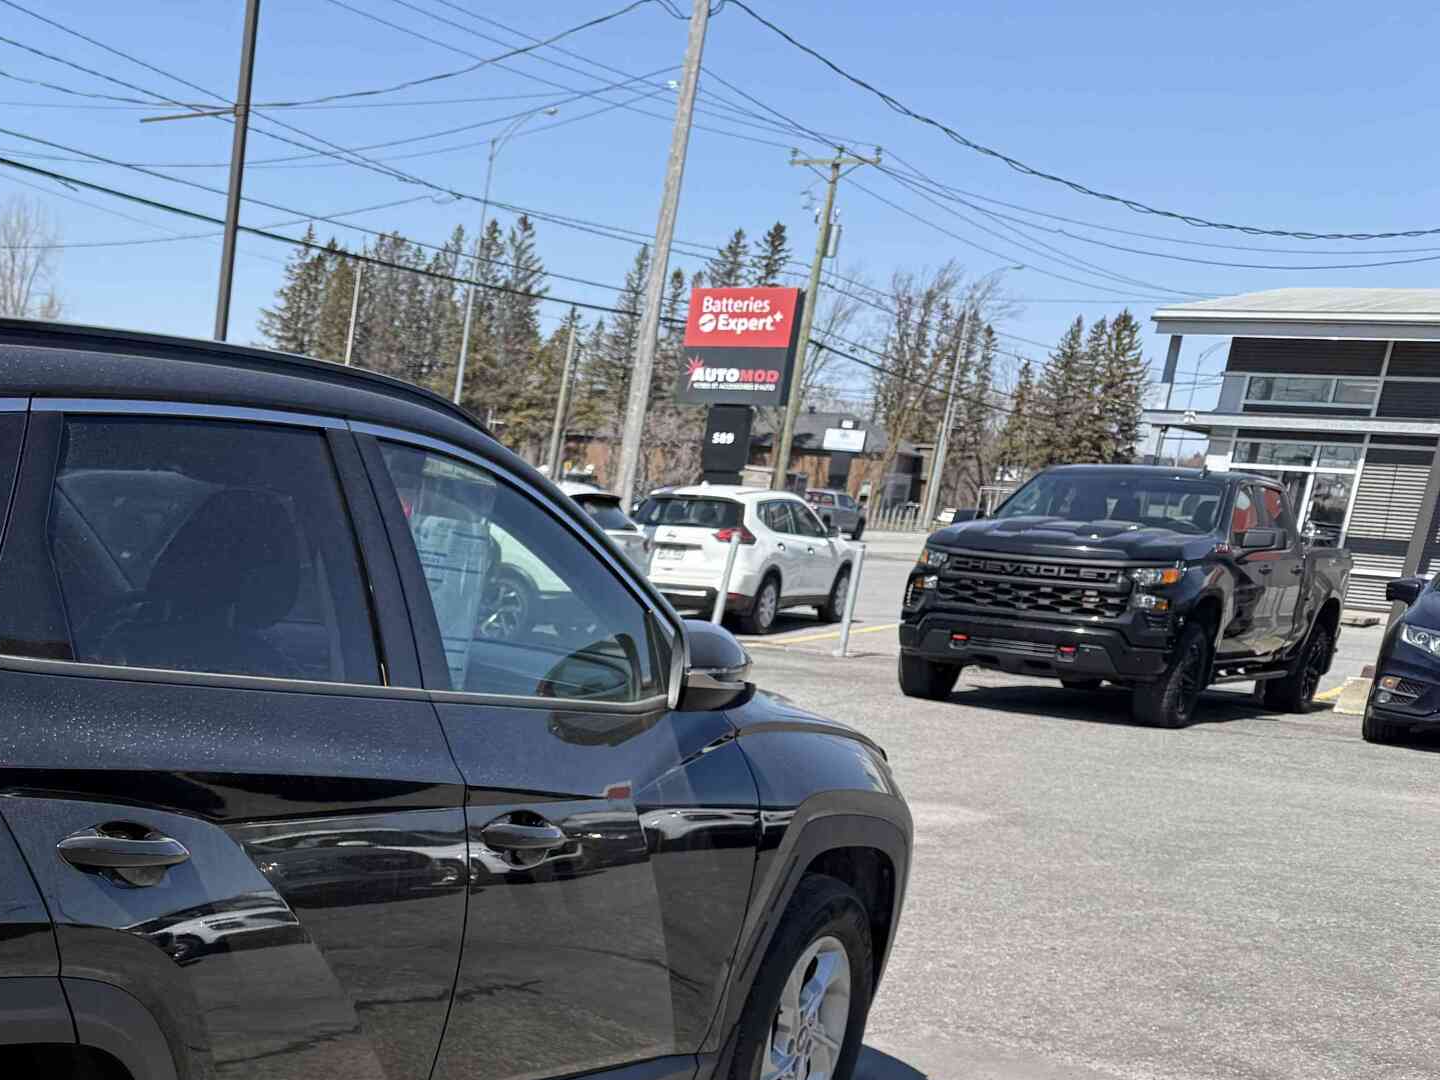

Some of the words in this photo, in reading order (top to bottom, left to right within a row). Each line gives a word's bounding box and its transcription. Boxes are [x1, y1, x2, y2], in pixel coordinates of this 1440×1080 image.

[702, 296, 771, 313] Batteries
[691, 367, 780, 383] AUTOMOD
[950, 558, 1118, 582] CHEVROLET
